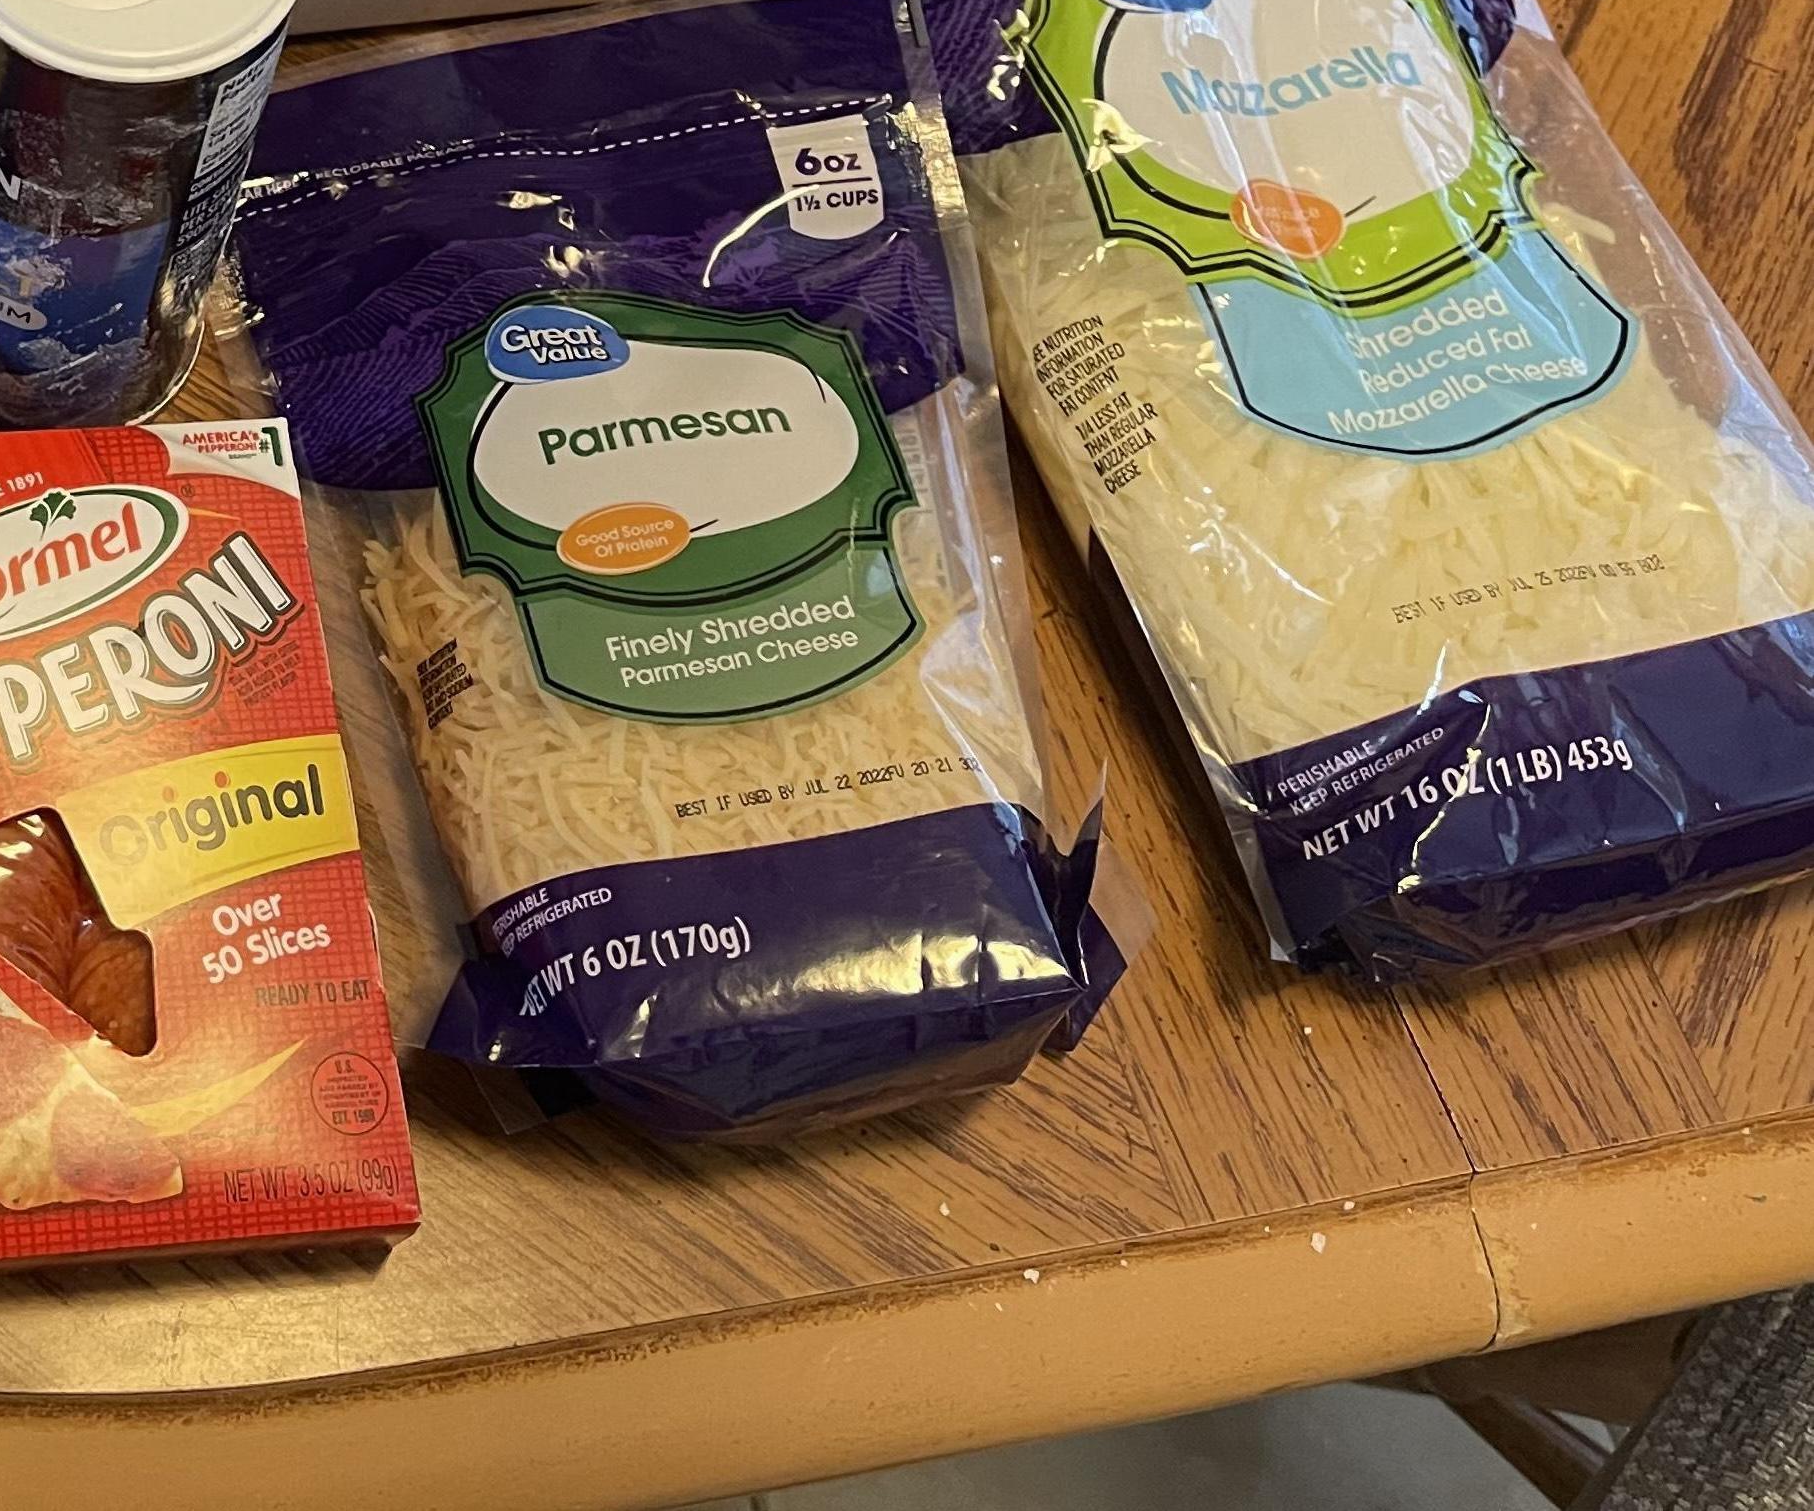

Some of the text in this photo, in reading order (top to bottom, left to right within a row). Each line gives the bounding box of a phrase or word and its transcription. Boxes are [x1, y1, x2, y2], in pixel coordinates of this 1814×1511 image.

[795, 147, 862, 176] 6oz
[826, 189, 879, 208] CUPS
[499, 323, 603, 355] Great
[1042, 314, 1104, 355] NUTRITION
[1345, 288, 1510, 360] Shredded
[527, 342, 609, 365] Value
[1036, 331, 1105, 384] INFORMATION
[1045, 342, 1126, 400] FOR SATURATED
[1359, 322, 1534, 395] Reduced Fat
[1058, 365, 1120, 417] FAT CONTENT
[1075, 391, 1133, 441] 1/4 LESS FAT
[1327, 355, 1588, 436] Mozzarella Cheese
[537, 403, 792, 467] Parmesan
[1084, 402, 1159, 459] THAN REGULAR
[1093, 426, 1157, 477] MOZZARELLA
[6, 471, 46, 497] 1891
[1103, 458, 1142, 495] CHEESE
[576, 519, 675, 546] Good Source
[616, 536, 669, 555] Protein
[604, 594, 858, 664] Finely Shredded
[1391, 600, 1427, 624] BEST
[1429, 595, 1446, 612] IF
[619, 627, 860, 689] Parmesan Cheese
[1277, 739, 1377, 799] PERISHABLE
[1289, 726, 1445, 817] KEEP REFRIGERATED
[98, 762, 326, 867] Original
[674, 798, 708, 818] BEST
[716, 794, 731, 811] IF
[739, 788, 773, 806] USED
[778, 785, 795, 800] BY
[804, 779, 830, 796] JUL
[834, 774, 853, 789] 22
[1302, 818, 1352, 861] NET
[1354, 795, 1398, 834] WT
[1400, 775, 1439, 810] 16
[1485, 756, 1514, 796] (1
[1516, 744, 1563, 783] LB)
[1567, 735, 1634, 772] 453g
[212, 892, 282, 936] Over
[515, 887, 612, 943] REFRIGERATED
[202, 923, 331, 985] 50 Slices
[541, 953, 575, 997] WT
[582, 946, 601, 977] 6
[605, 934, 647, 970] OZ
[651, 916, 751, 967] (170g)
[256, 979, 370, 1006] READY TO EAT
[223, 1168, 255, 1203] NET
[259, 1164, 288, 1201] WT
[328, 1161, 354, 1194] OZ
[356, 1157, 401, 1198] (99g)
